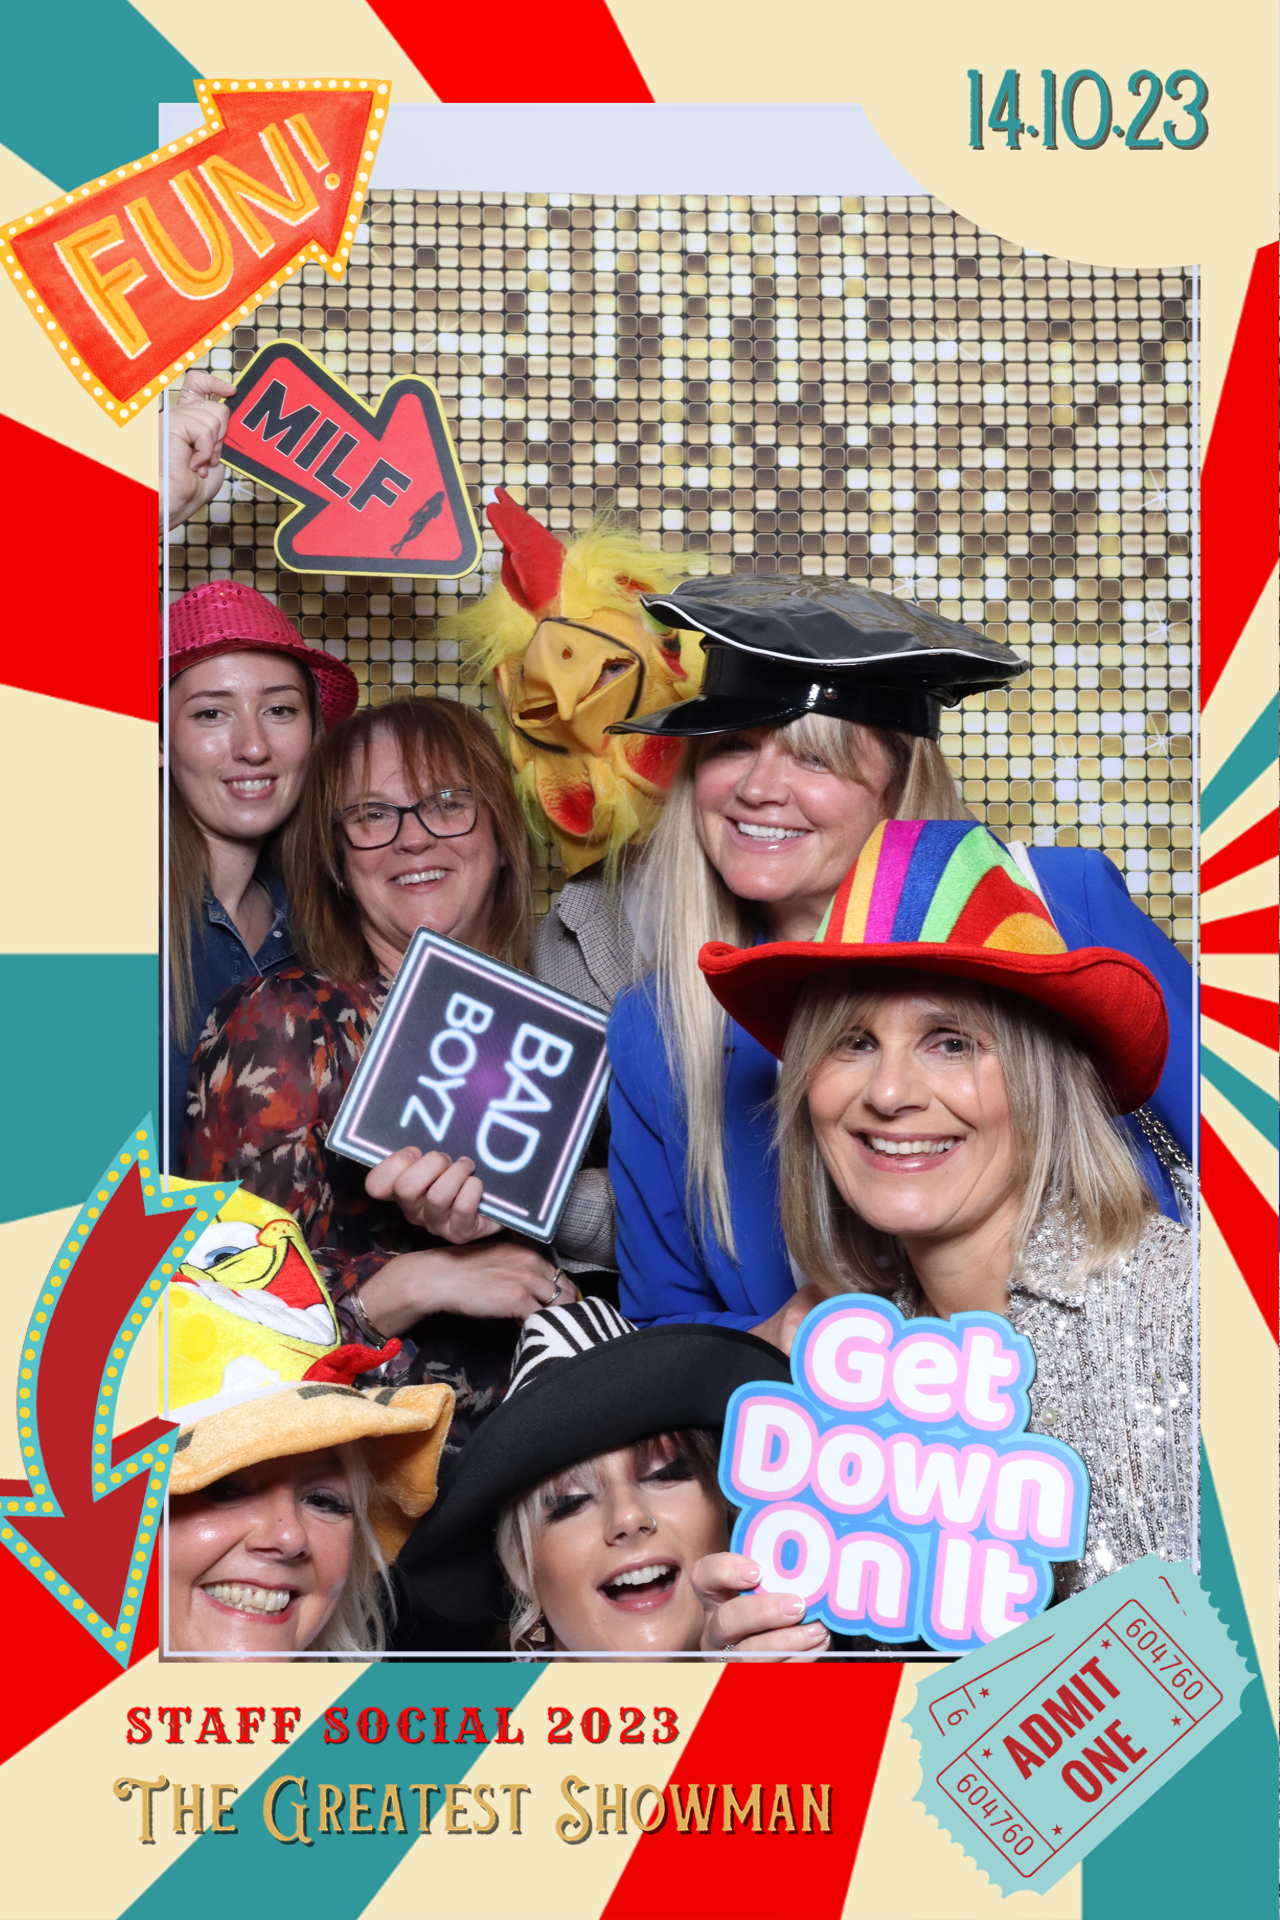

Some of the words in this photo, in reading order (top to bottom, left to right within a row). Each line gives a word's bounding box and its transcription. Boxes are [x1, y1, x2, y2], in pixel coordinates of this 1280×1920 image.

[241, 378, 413, 512] MILF
[401, 991, 494, 1142] BOYZ
[476, 1023, 573, 1172] BAD
[811, 1316, 1014, 1424] Get
[737, 1404, 1067, 1540] Down
[750, 1508, 904, 1620] On
[942, 1538, 1030, 1641] It
